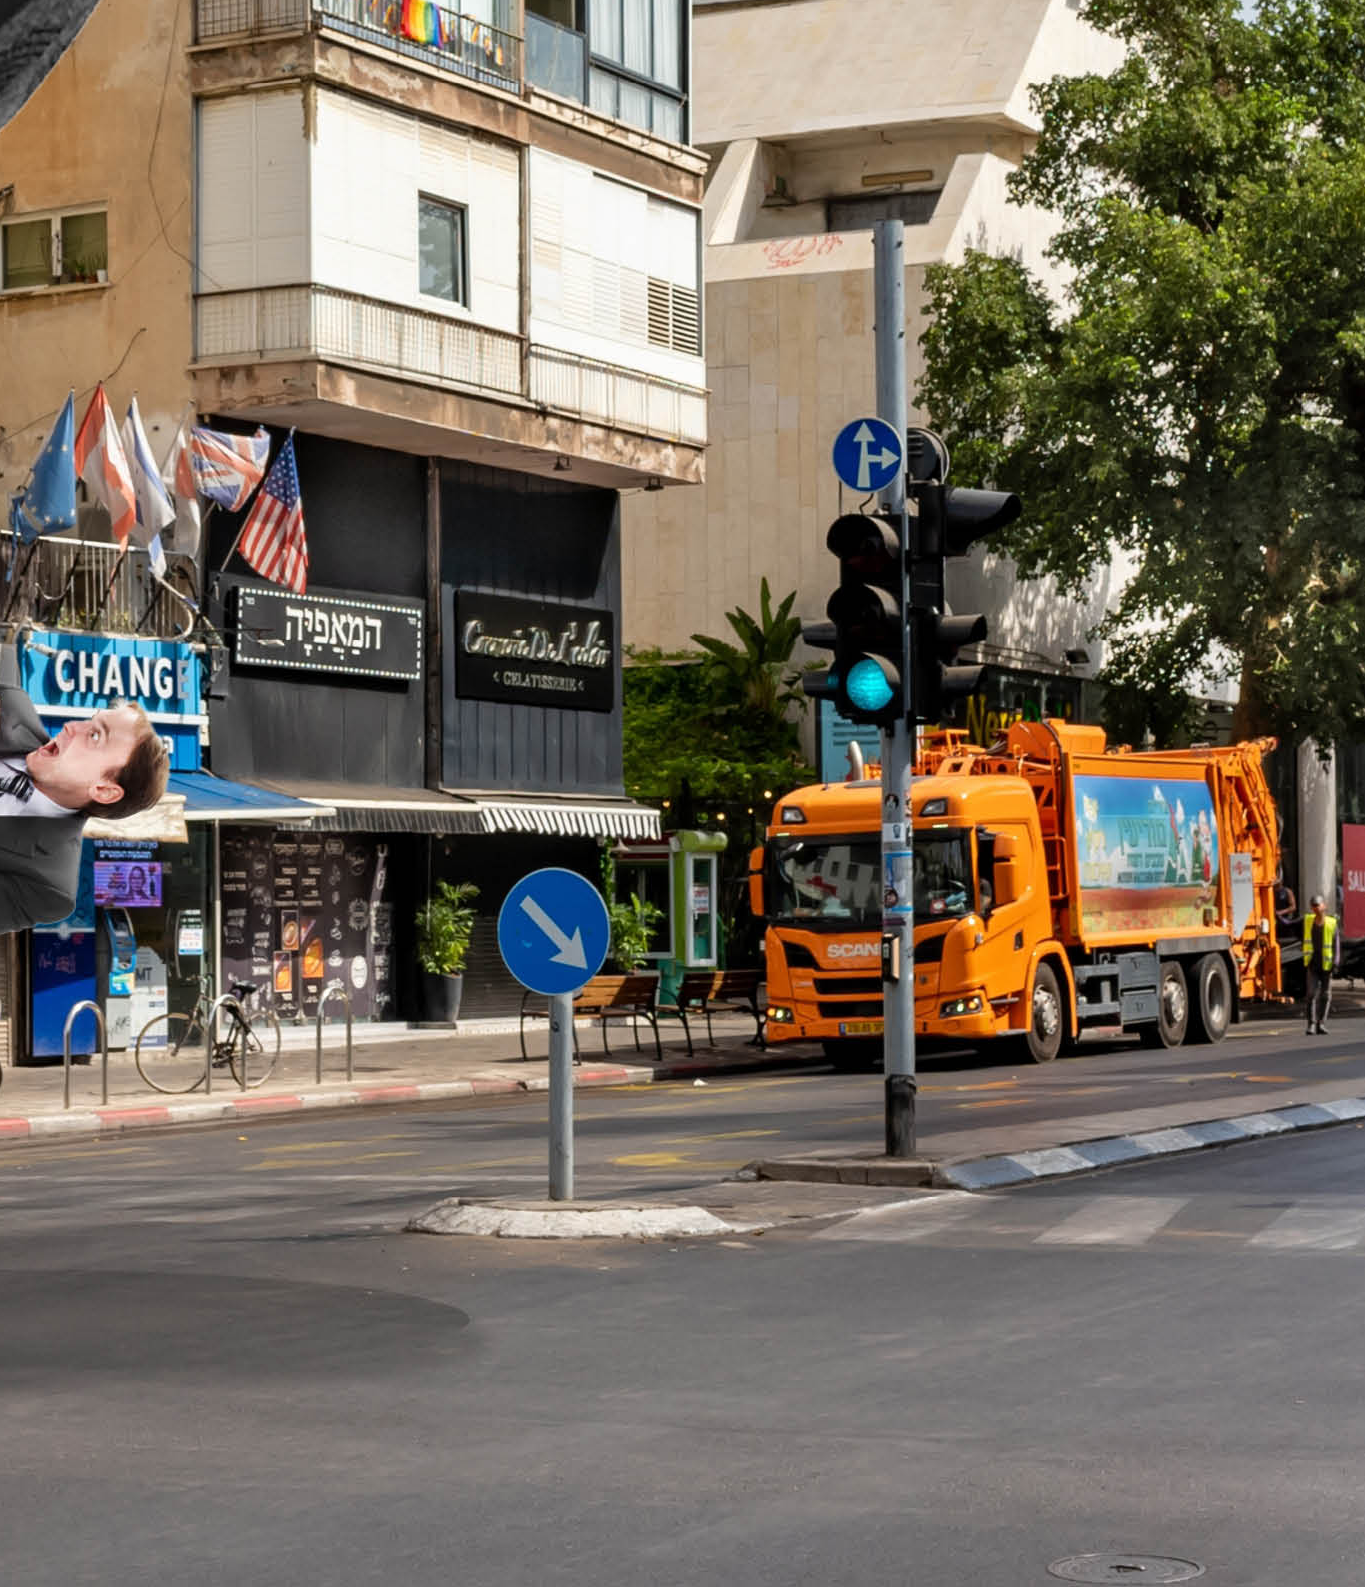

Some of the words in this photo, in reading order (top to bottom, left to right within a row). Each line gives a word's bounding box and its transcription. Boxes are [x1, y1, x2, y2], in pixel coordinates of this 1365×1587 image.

[54, 648, 190, 700] CHANGE
[503, 670, 578, 693] GELATISSERIE
[827, 943, 882, 958] SCAN
[135, 966, 153, 981] MT
